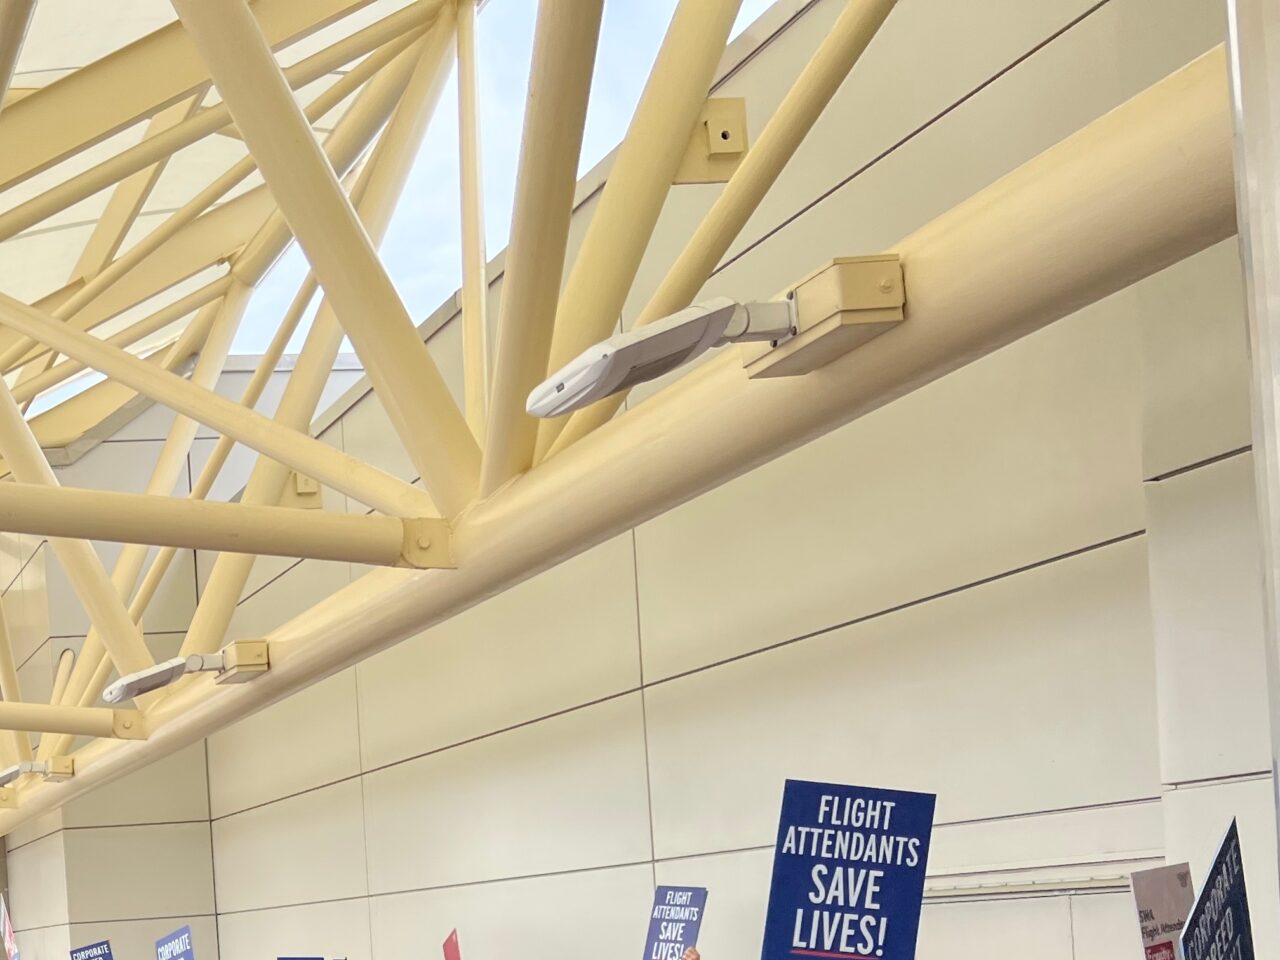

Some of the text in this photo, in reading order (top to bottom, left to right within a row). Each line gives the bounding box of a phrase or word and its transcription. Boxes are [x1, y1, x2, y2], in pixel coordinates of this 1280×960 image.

[818, 795, 896, 830] FLIGHT
[781, 825, 920, 867] ATTENDANTS
[665, 891, 692, 905] FLIGHT
[808, 863, 884, 910] SAVE
[653, 905, 699, 921] ATTENDANTS
[659, 921, 685, 941] SAVE
[792, 908, 888, 957] LIVES!
